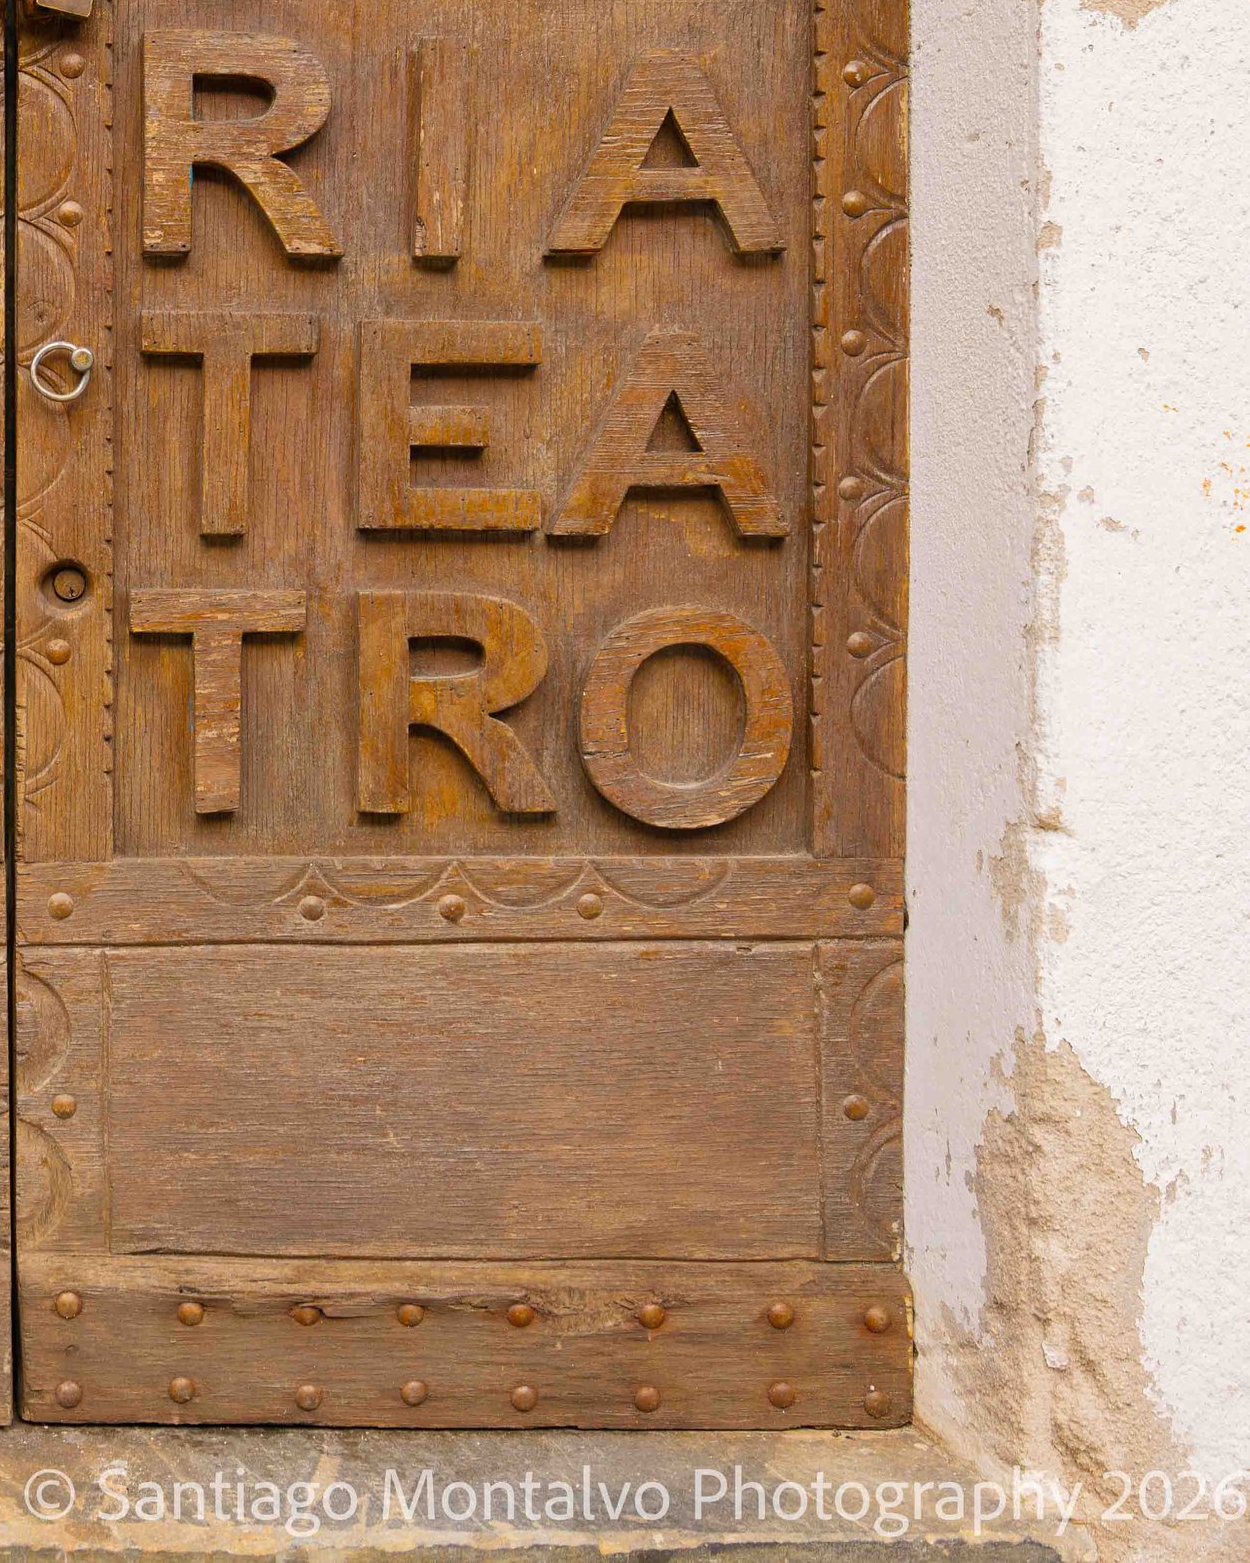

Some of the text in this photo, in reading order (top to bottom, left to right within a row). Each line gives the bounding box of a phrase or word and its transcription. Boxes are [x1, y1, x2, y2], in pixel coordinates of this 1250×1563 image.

[142, 30, 787, 261] RIA
[140, 310, 791, 540] TEA
[129, 589, 794, 830] TRO
